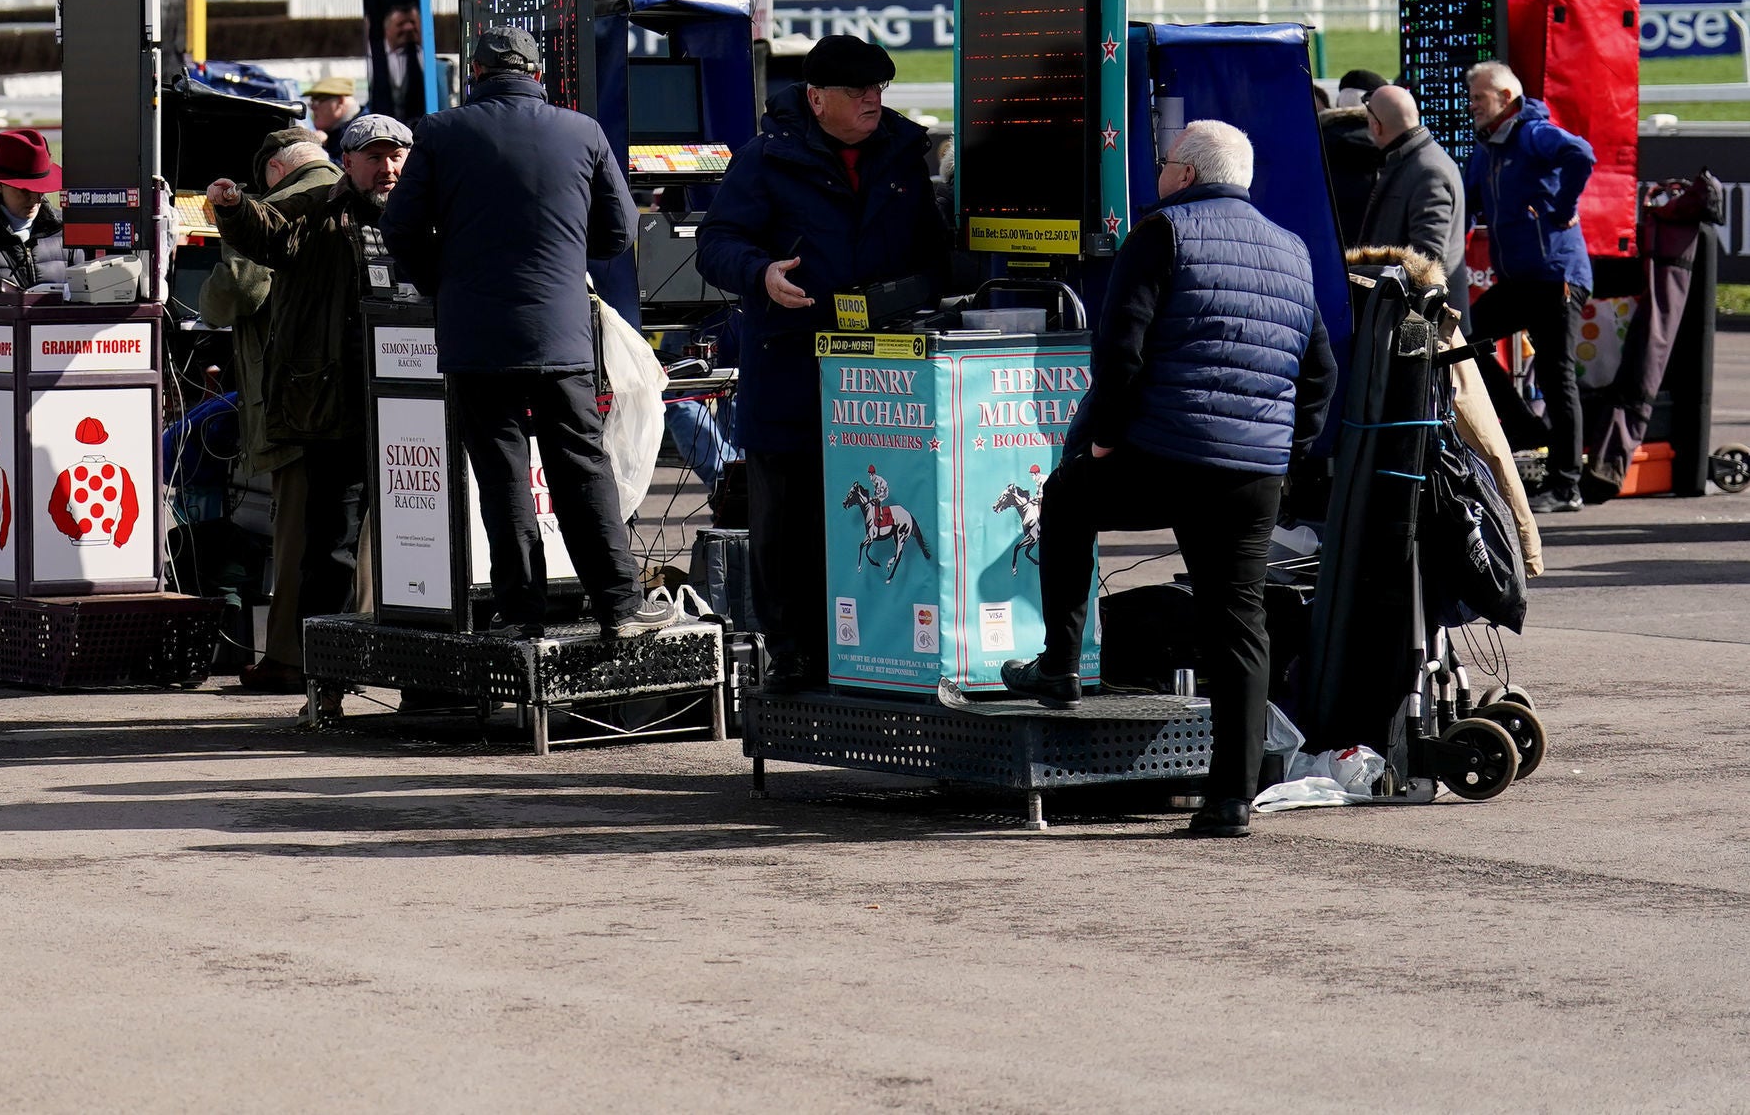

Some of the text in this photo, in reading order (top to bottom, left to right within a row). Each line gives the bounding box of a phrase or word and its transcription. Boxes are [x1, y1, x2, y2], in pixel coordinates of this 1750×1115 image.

[773, 5, 911, 47] TING
[1639, 10, 1729, 51] ose
[971, 228, 984, 237] Min
[985, 229, 998, 239] Bet:
[999, 229, 1018, 240] £5.00
[1019, 230, 1034, 240] Win
[1034, 230, 1044, 240] Or
[1044, 230, 1063, 241] £2.50
[42, 339, 141, 355] GRAHAM THORPE
[382, 342, 438, 356] SIMON JAMES
[819, 339, 827, 353] 21
[831, 340, 841, 351] NO
[842, 340, 849, 351] ID
[851, 341, 862, 351] NO
[914, 341, 923, 353] 21
[398, 359, 421, 367] RACING
[840, 367, 917, 395] HENRY
[832, 398, 936, 429] MICHAEL
[978, 399, 1078, 427] MICHA
[841, 432, 923, 450] BOOKMAKERS
[992, 431, 1066, 449] BOOKMA
[387, 444, 440, 468] SIMON
[387, 469, 441, 494] JAMES
[394, 495, 436, 510] RACING
